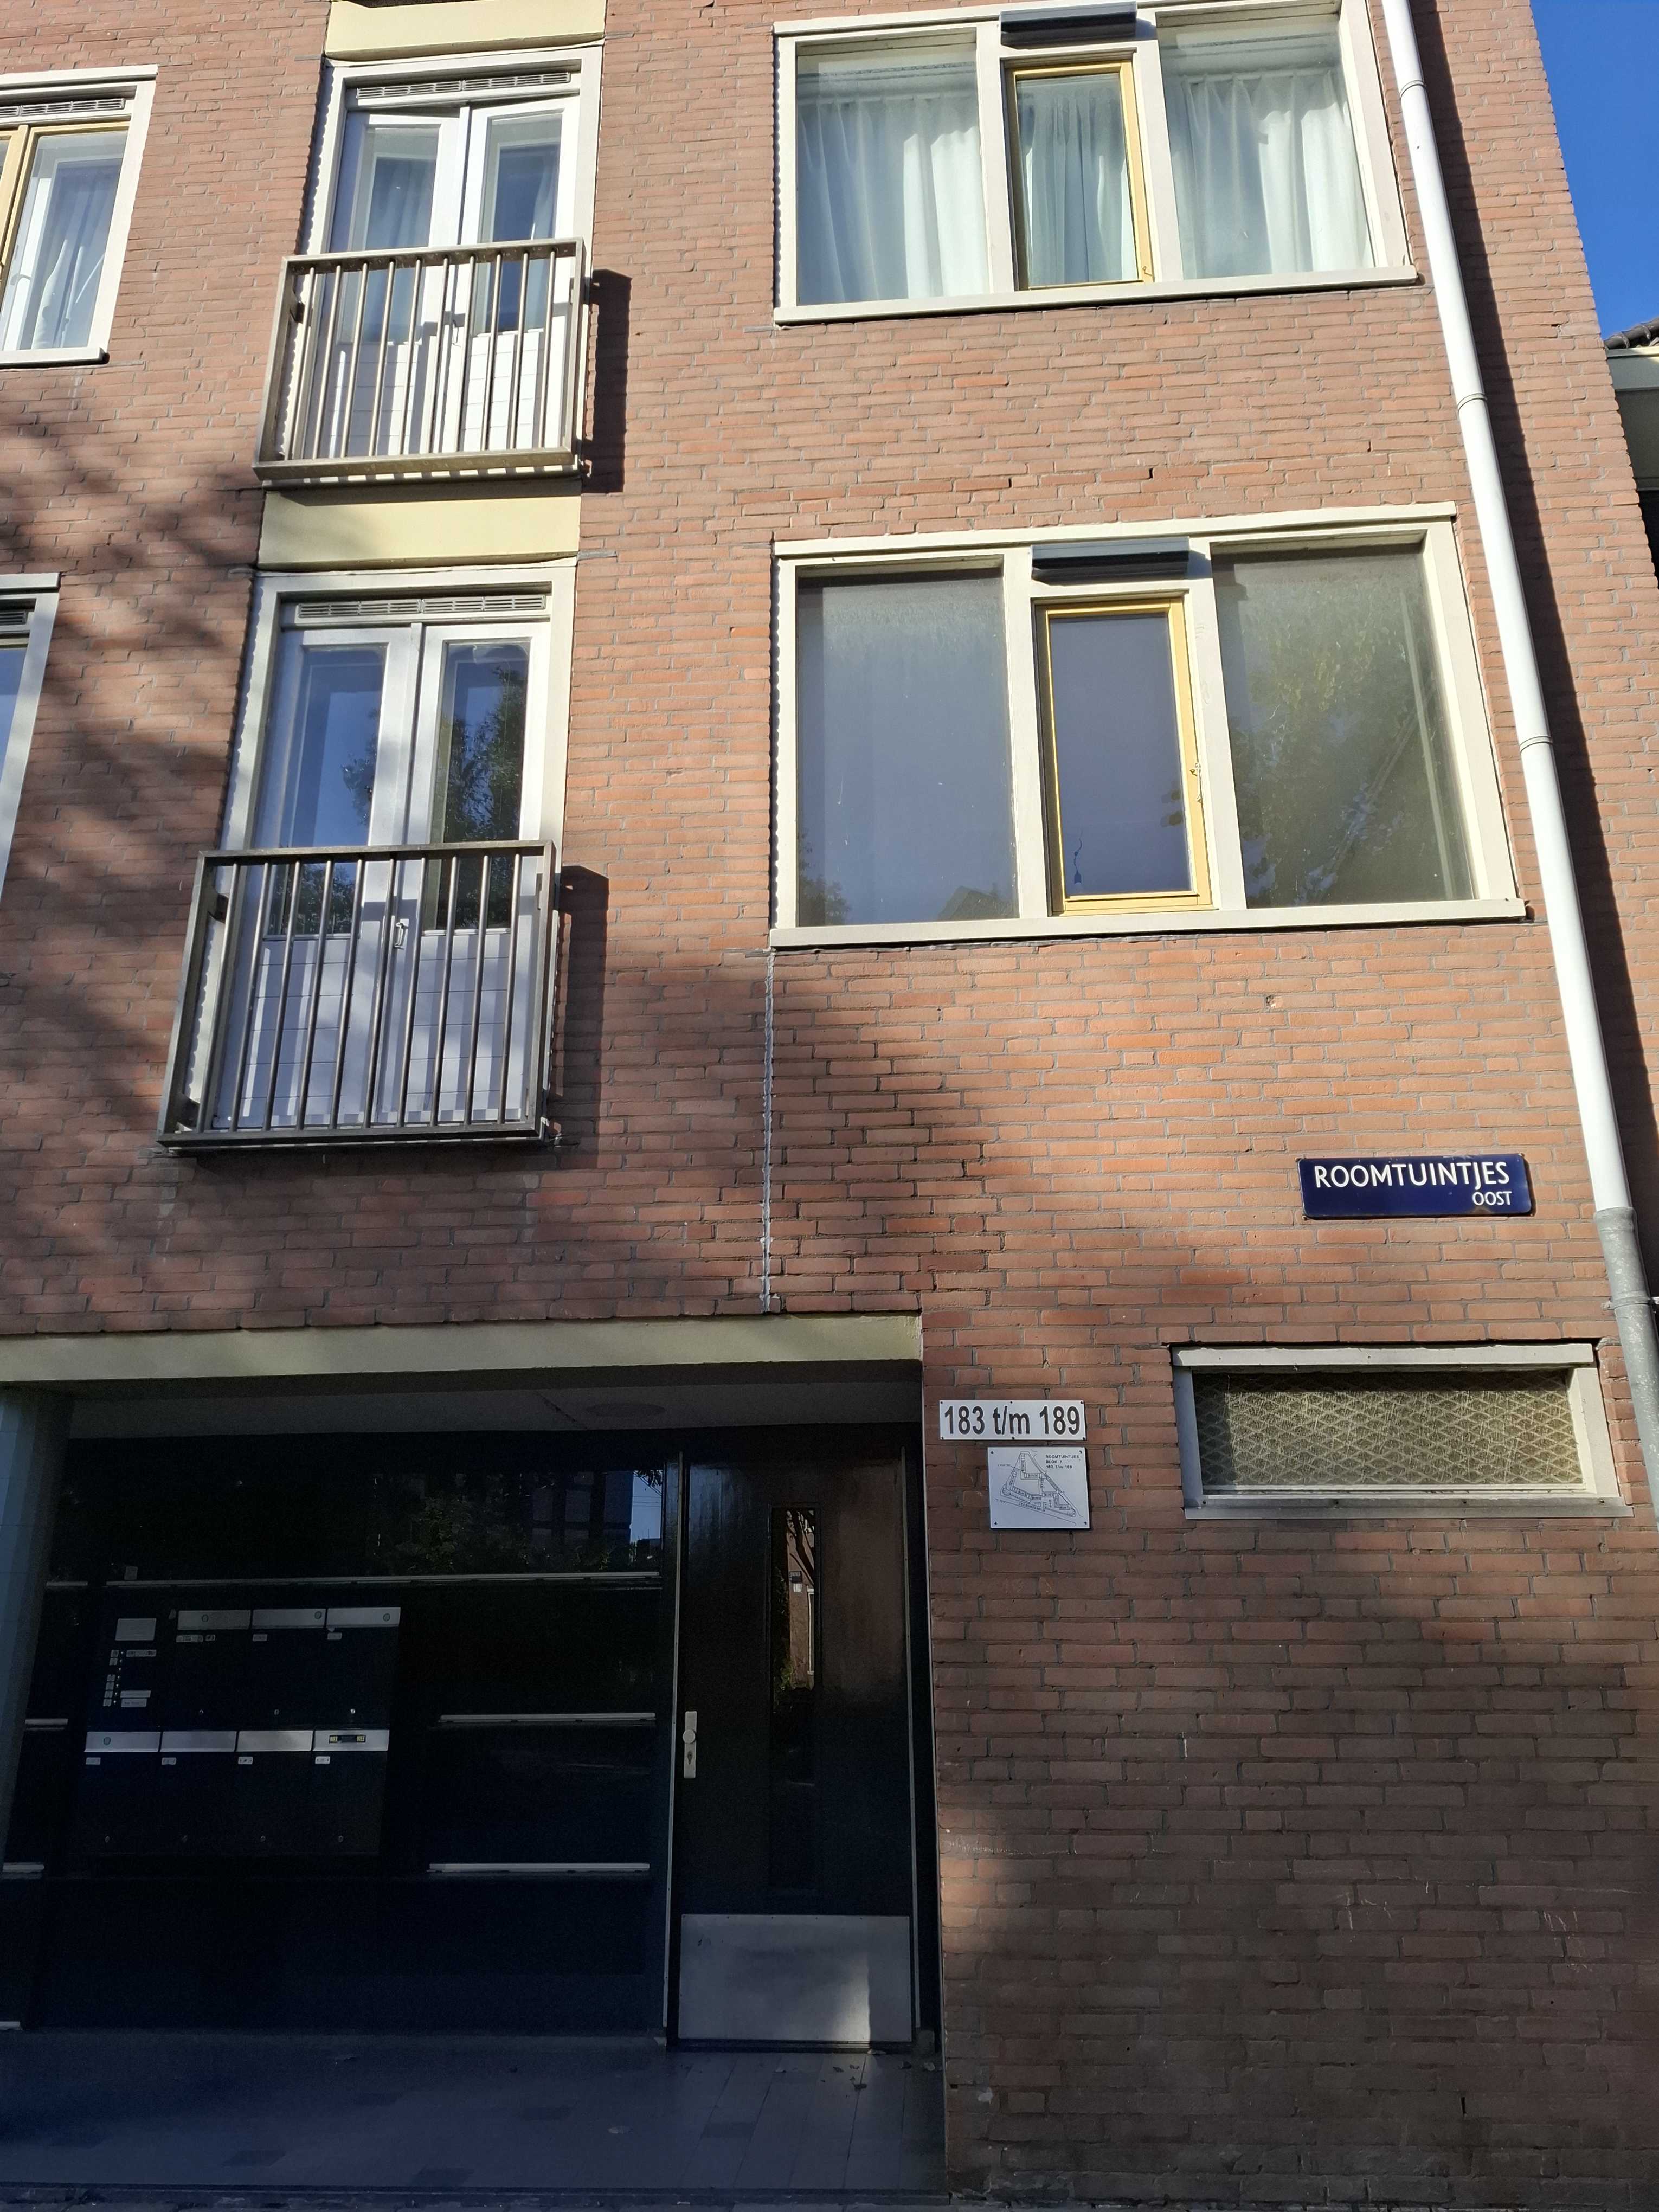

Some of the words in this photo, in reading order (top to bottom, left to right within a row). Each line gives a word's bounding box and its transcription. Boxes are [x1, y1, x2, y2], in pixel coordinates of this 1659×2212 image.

[1315, 1162, 1510, 1190] ROOMTUINTJES
[1472, 1191, 1512, 1206] OOST
[944, 1405, 985, 1435] 183
[992, 1405, 1031, 1435] t/m
[1039, 1405, 1081, 1435] 189
